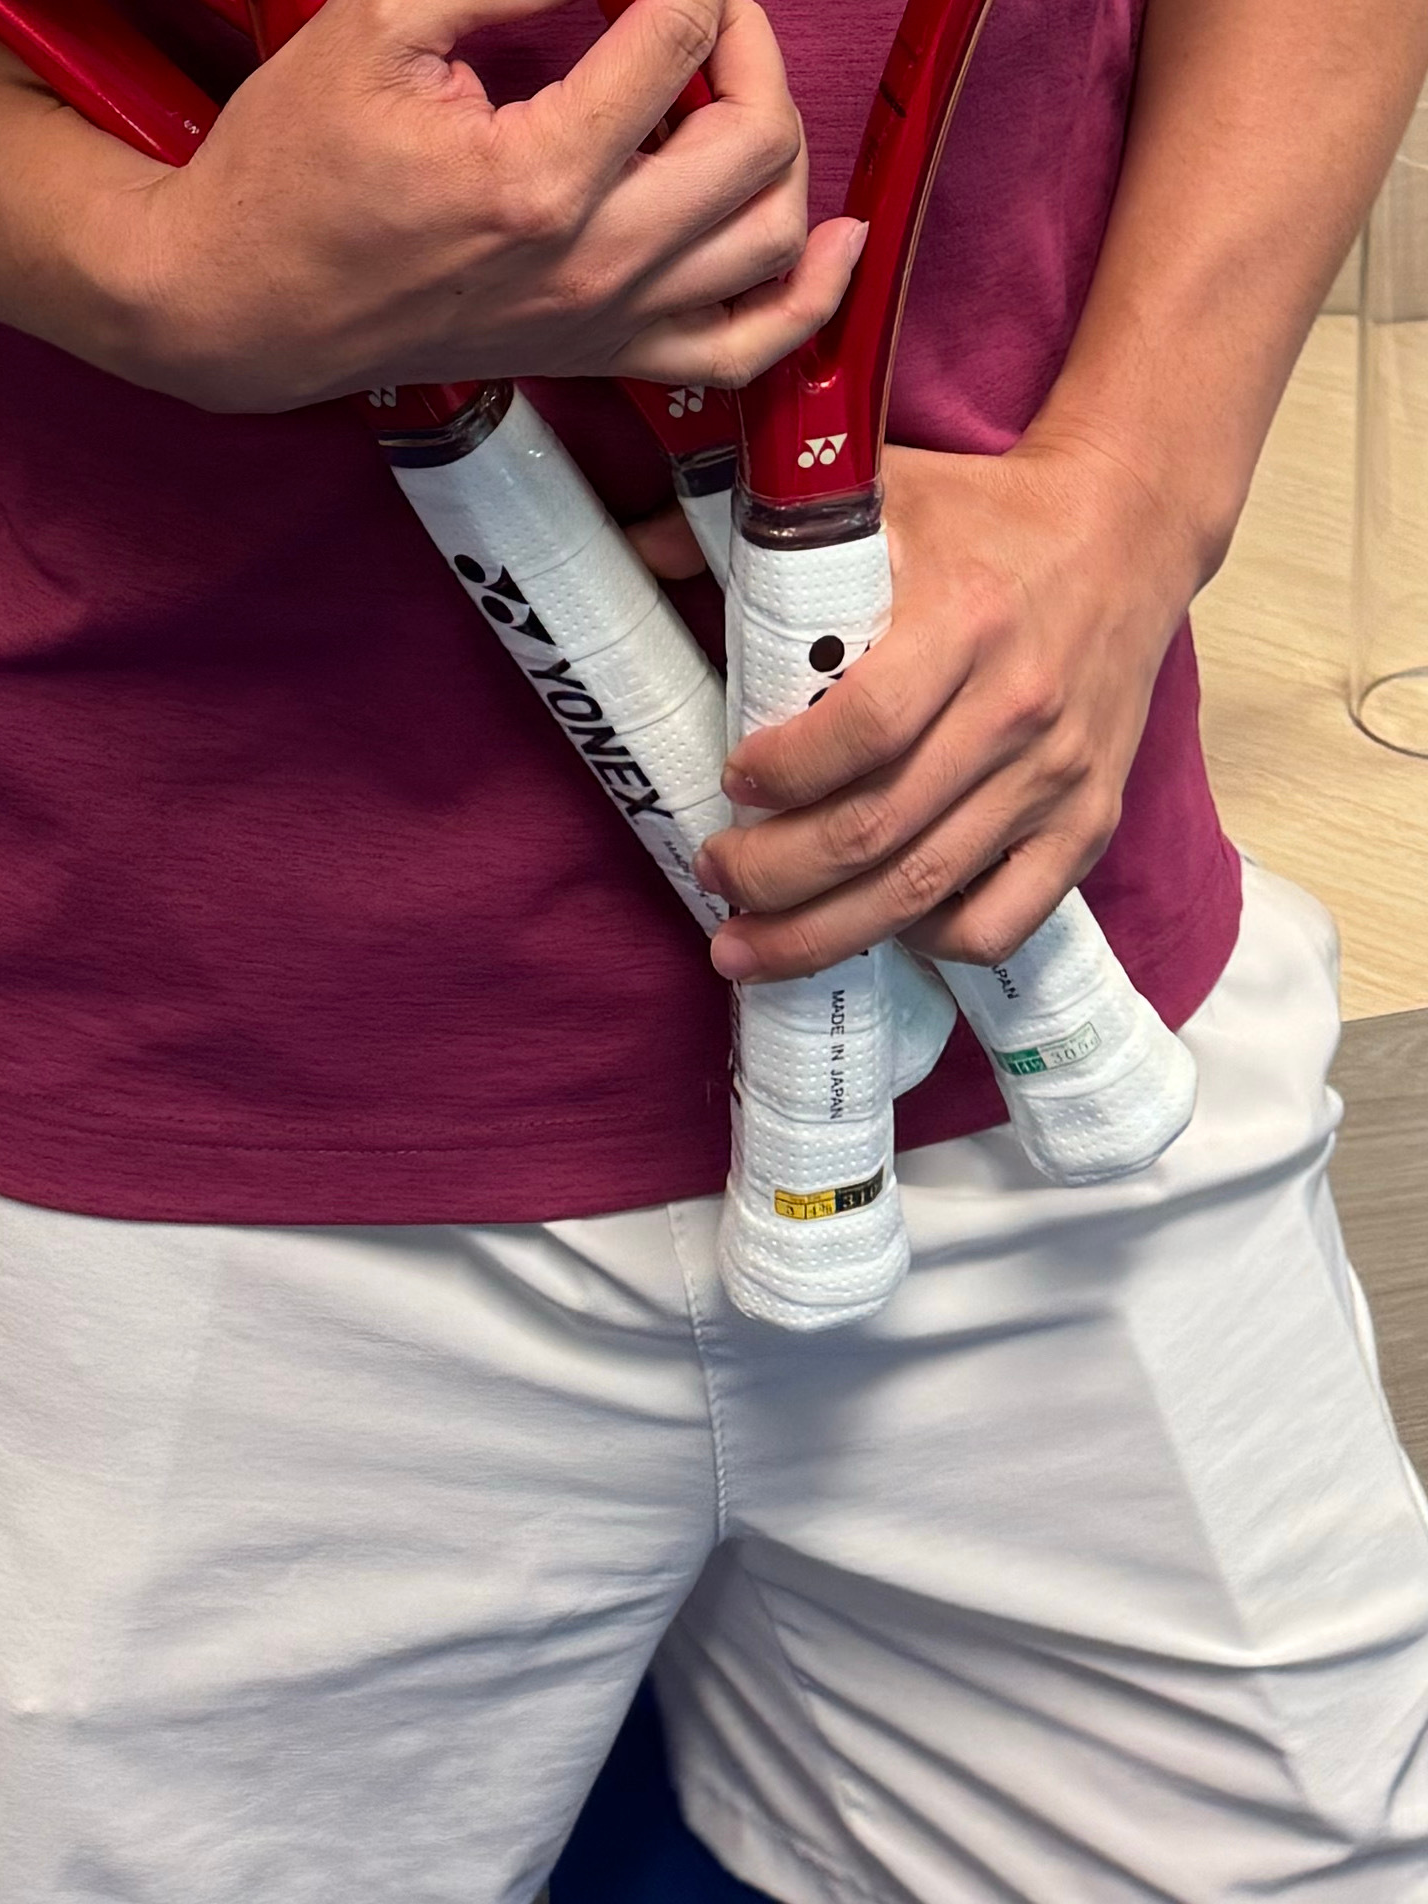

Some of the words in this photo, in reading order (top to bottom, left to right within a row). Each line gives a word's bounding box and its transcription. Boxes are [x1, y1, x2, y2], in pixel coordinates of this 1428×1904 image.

[526, 657, 675, 821] YONEX
[829, 989, 845, 1037] MADE
[830, 1043, 845, 1062] IN
[829, 1069, 845, 1121] JAPAN
